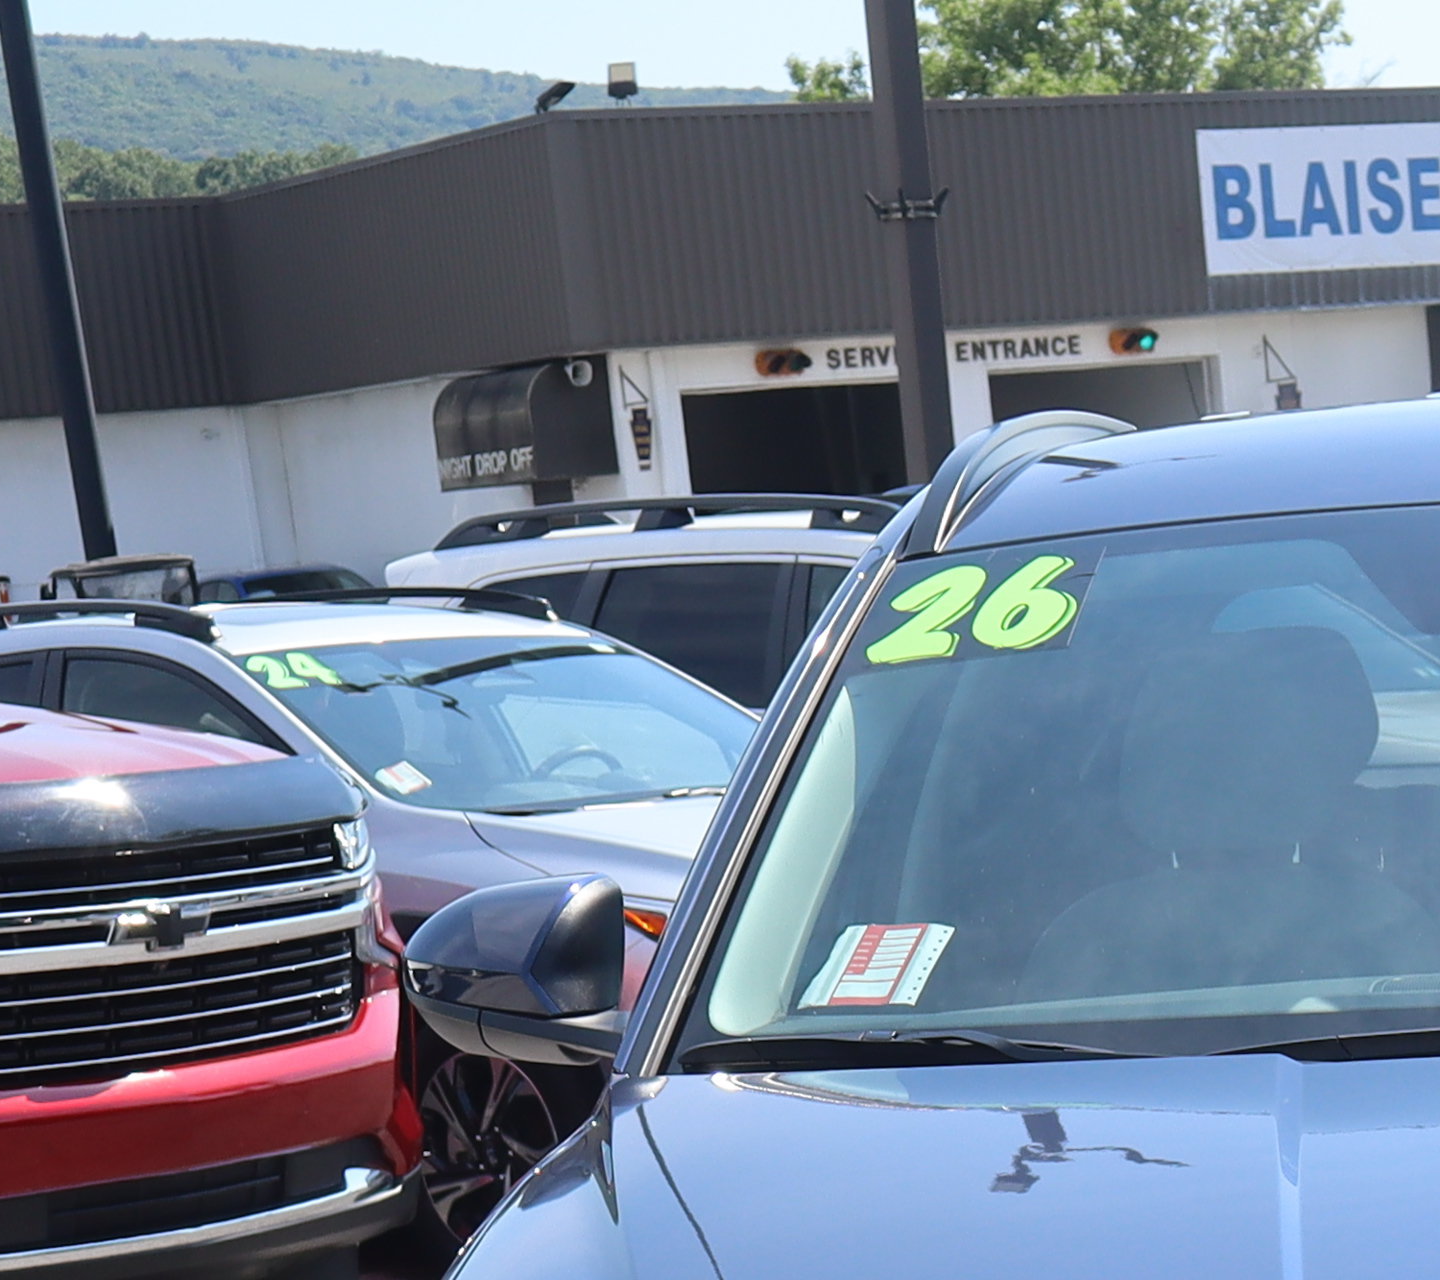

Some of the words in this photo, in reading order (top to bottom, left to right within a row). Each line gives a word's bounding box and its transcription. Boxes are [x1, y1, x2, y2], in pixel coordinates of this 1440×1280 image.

[826, 346, 897, 370] SERV
[955, 335, 1082, 363] ENTRANCE
[439, 454, 473, 481] NIGHT
[474, 449, 508, 477] DROP
[509, 446, 534, 471] OFF
[865, 555, 1078, 666] 26
[246, 651, 344, 690] 24
